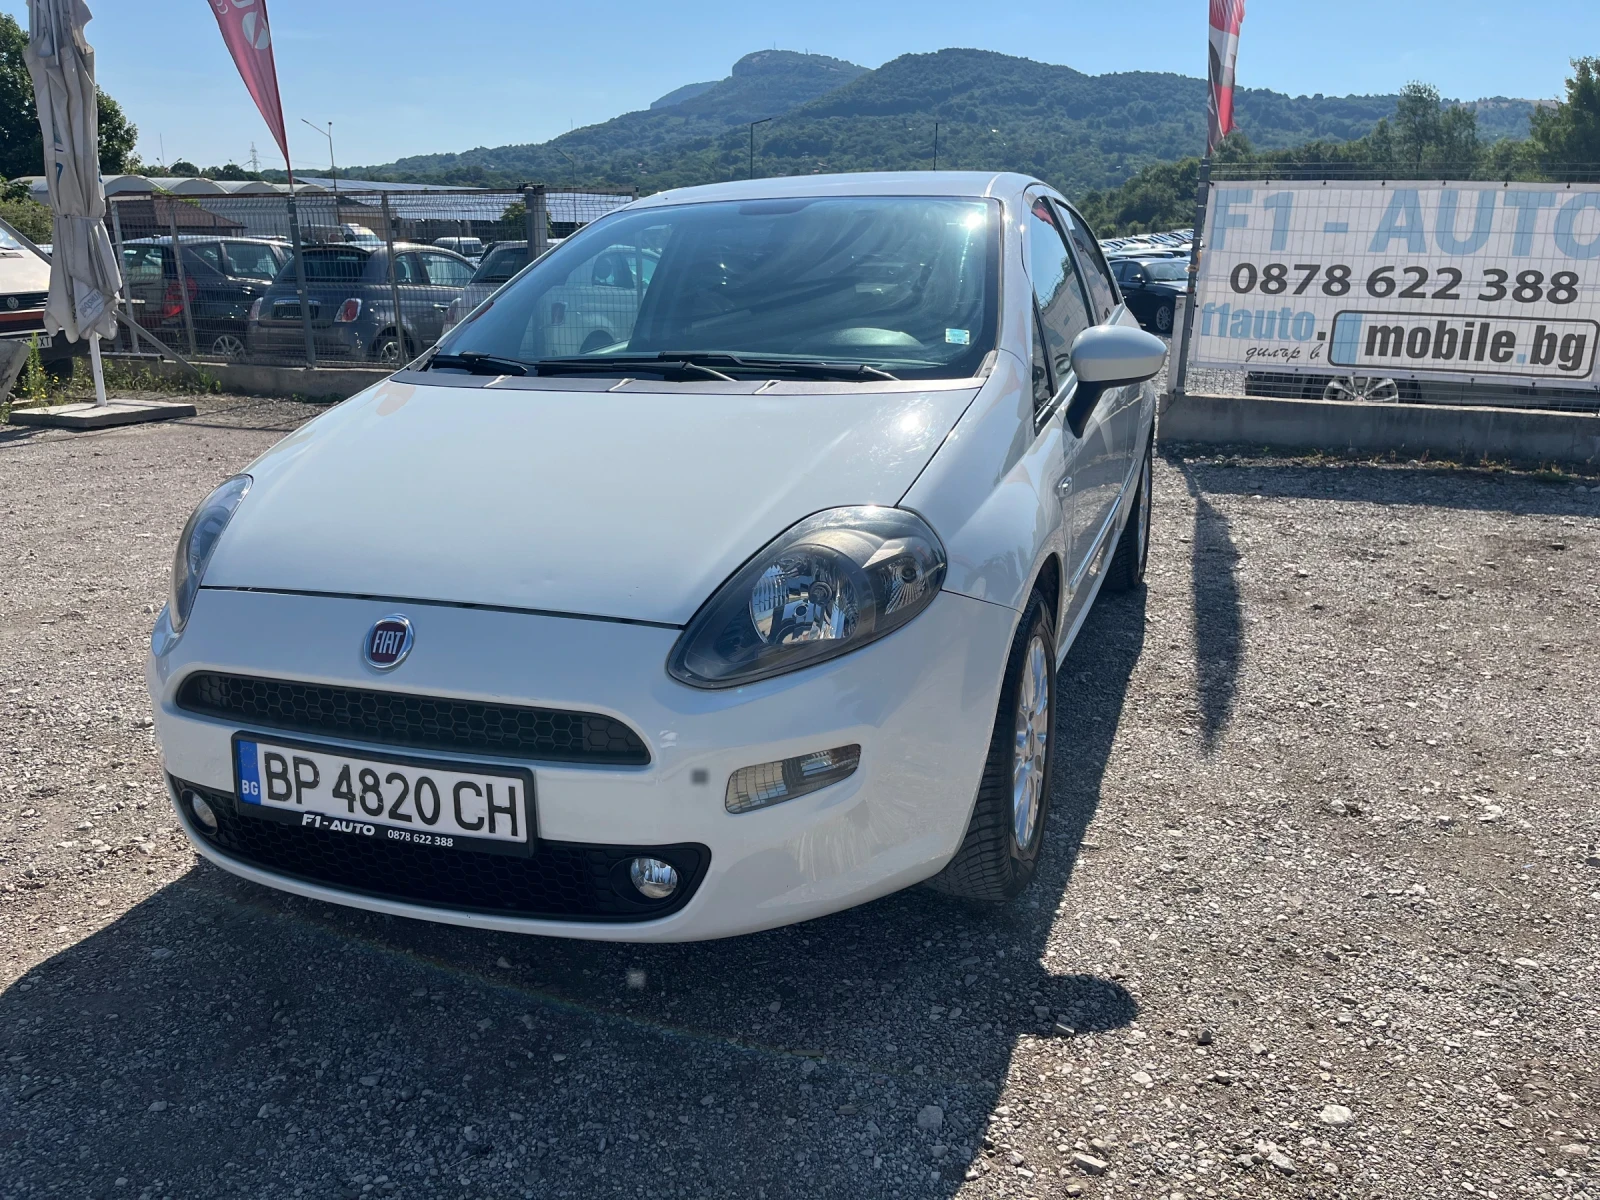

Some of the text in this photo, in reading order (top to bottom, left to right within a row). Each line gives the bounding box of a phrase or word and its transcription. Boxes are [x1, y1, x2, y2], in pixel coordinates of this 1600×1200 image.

[1210, 189, 1294, 251] F1
[1367, 189, 1600, 260] AUTO
[1230, 263, 1579, 305] 0878 622 388
[39, 336, 50, 347] XT
[1245, 343, 1324, 363] дилър в
[1364, 320, 1587, 371] mobile.bg
[372, 630, 404, 655] FIAT
[241, 779, 259, 796] BG
[264, 751, 518, 837] BP 4820 CH
[387, 829, 411, 843] 0878
[413, 833, 432, 845] 622
[434, 836, 454, 848] 388
